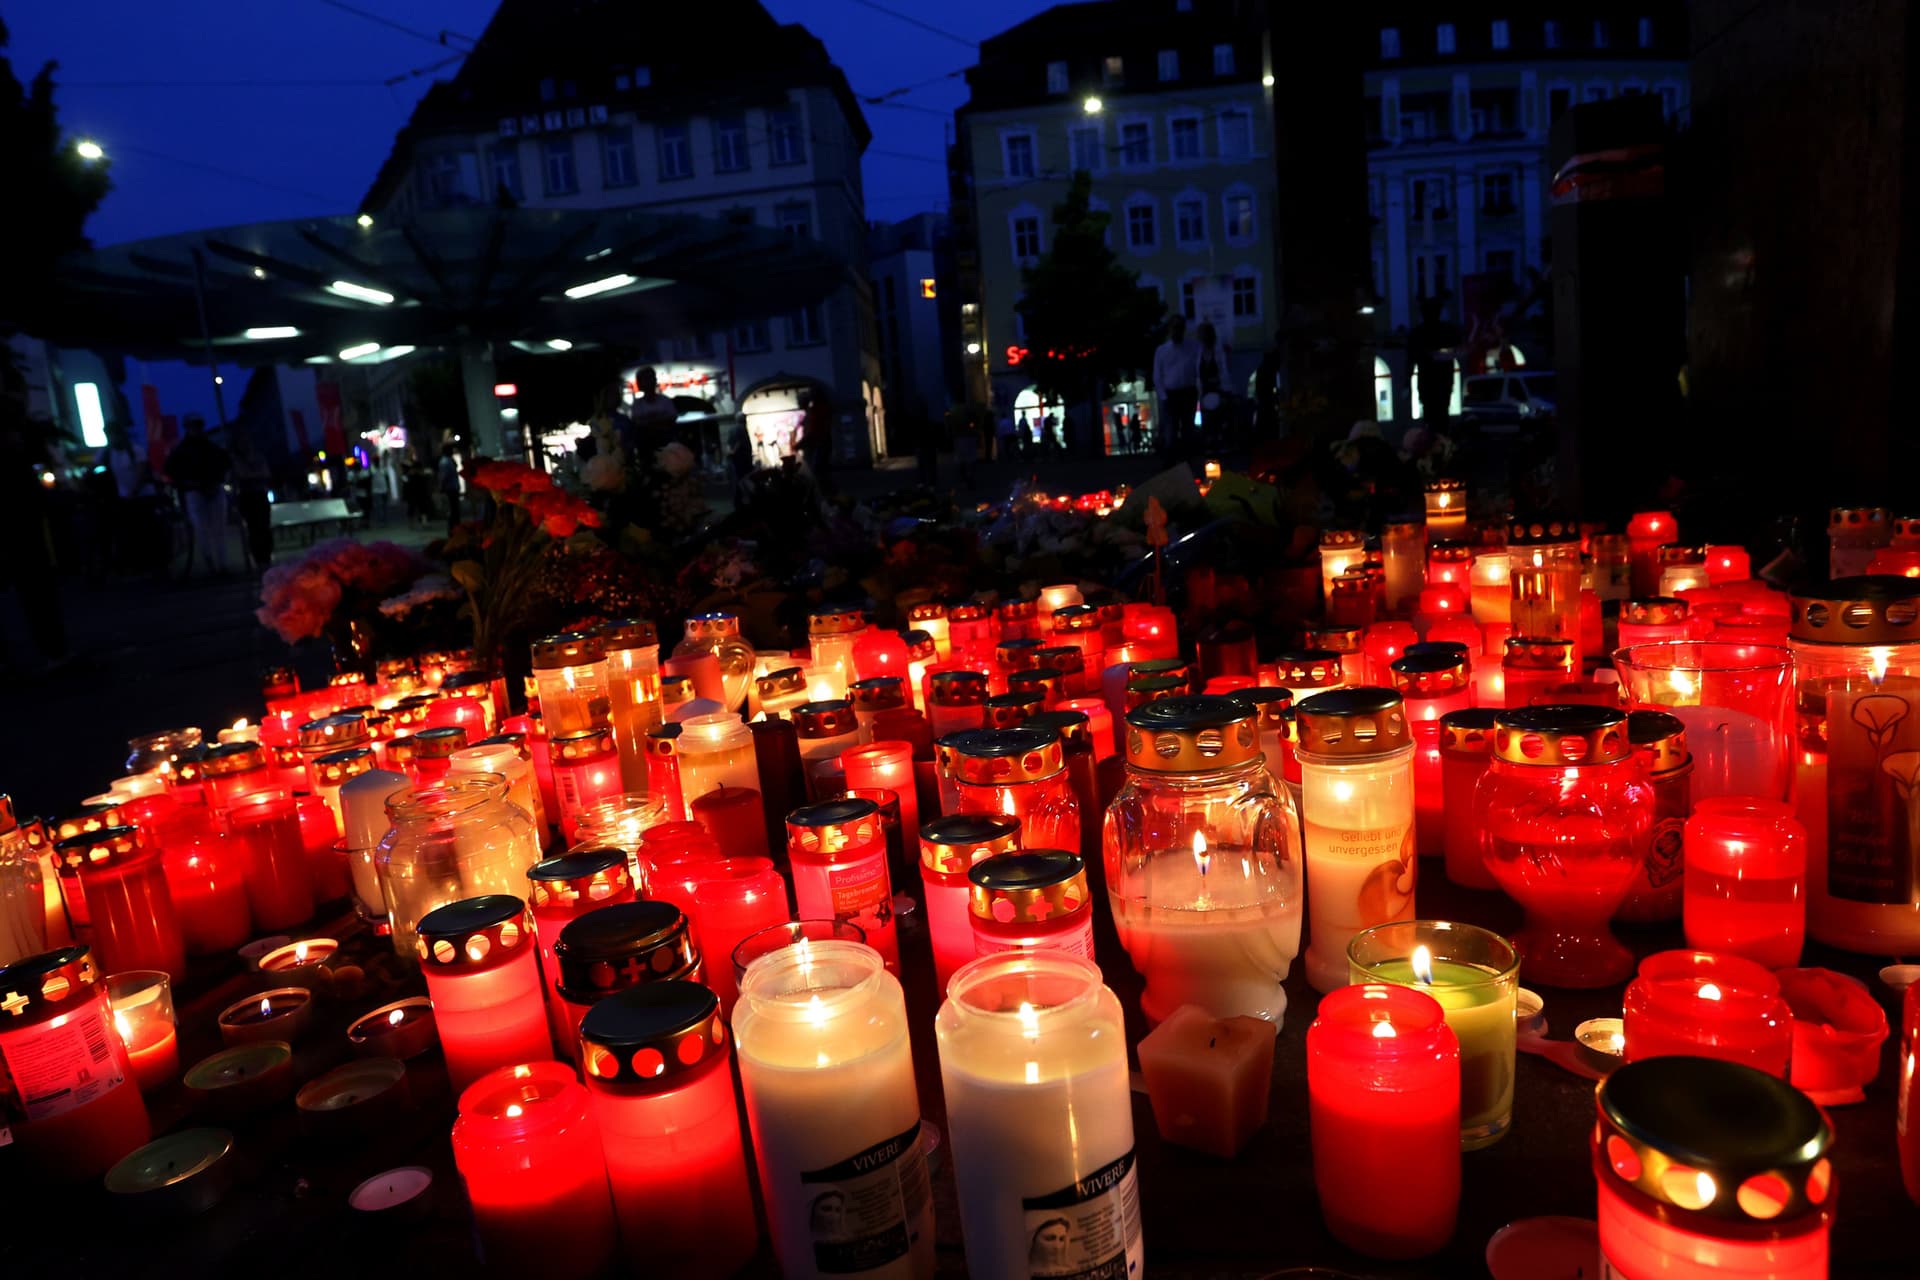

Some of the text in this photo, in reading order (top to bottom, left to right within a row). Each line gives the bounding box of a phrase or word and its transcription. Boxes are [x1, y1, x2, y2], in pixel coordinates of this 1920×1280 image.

[1341, 831, 1381, 842] Geliebt
[1329, 843, 1398, 857] unvergessen
[1080, 1160, 1126, 1197] VIVERE
